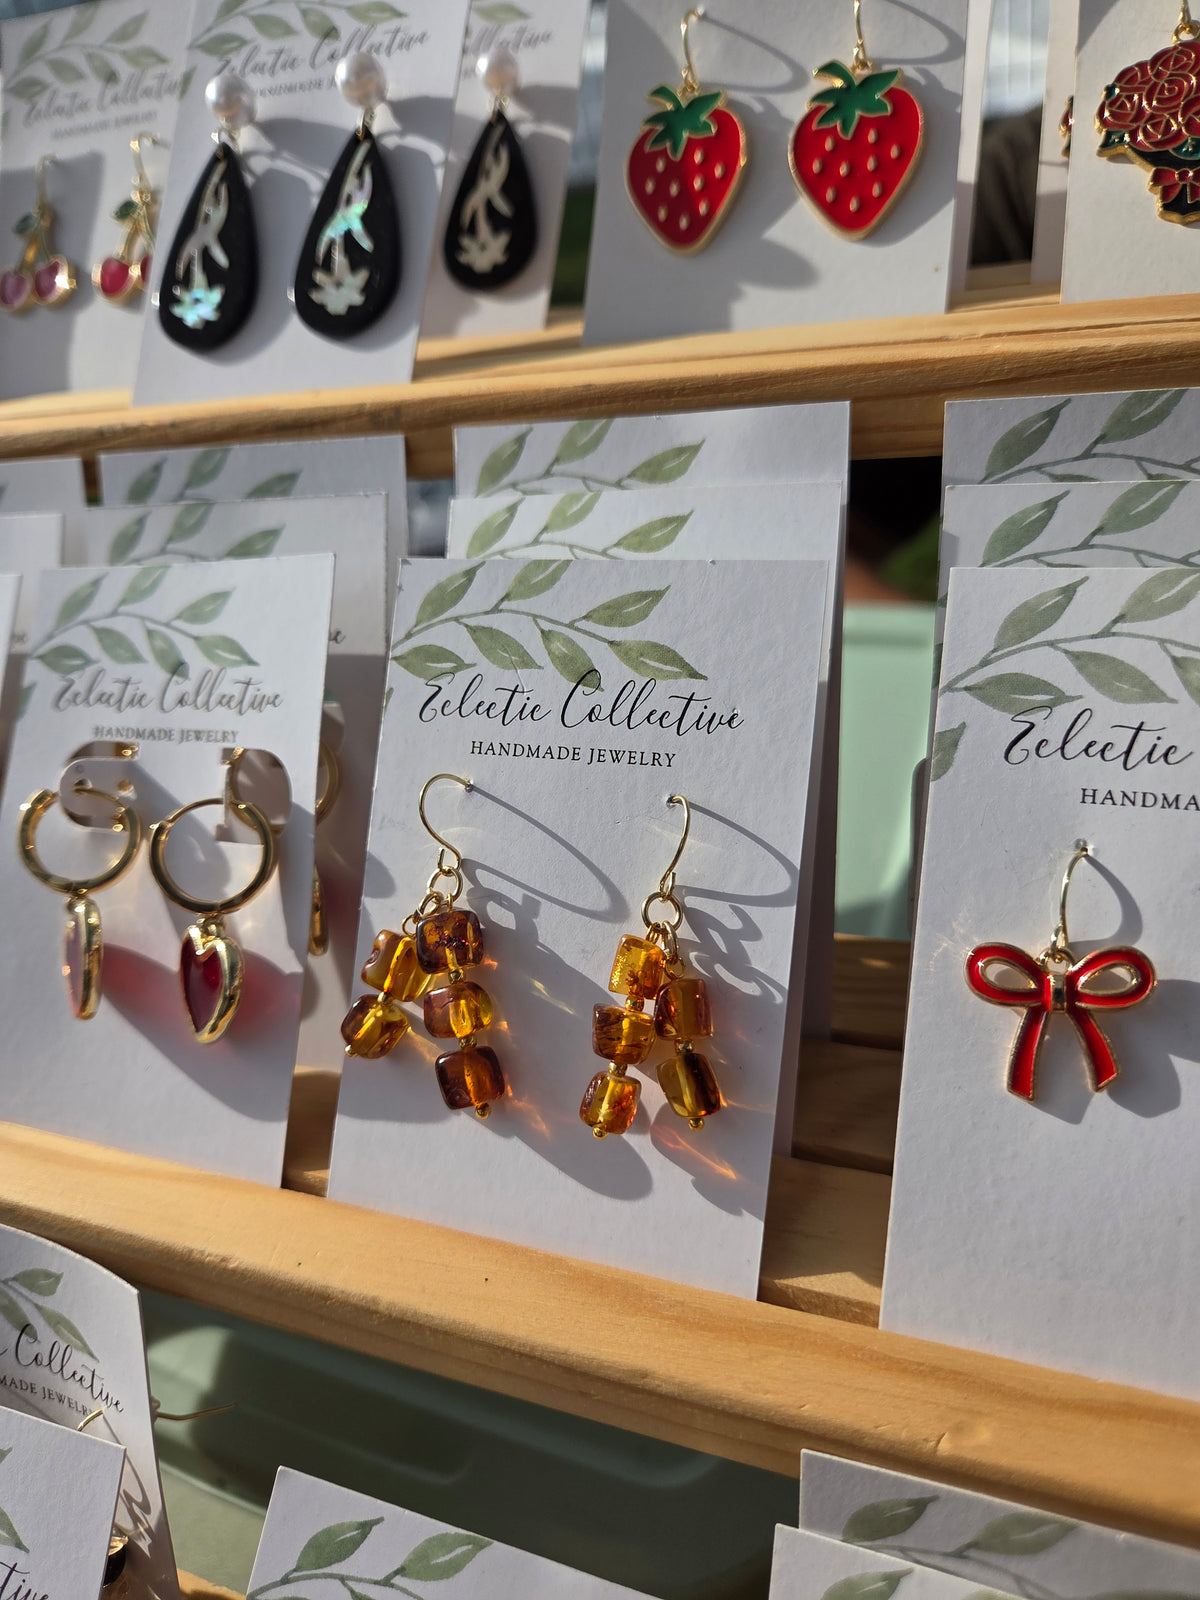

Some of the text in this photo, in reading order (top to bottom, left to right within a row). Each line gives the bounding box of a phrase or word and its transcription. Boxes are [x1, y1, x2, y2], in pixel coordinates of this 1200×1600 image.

[54, 661, 284, 716] Eclectic Collective
[418, 668, 745, 737] Eclectic Collective
[92, 725, 239, 744] HANDMADE JEWELRY
[470, 740, 677, 769] HANDMADE JEWELRY
[1003, 705, 1195, 772] Eclectic
[1079, 787, 1200, 812] HANDMA
[15, 1323, 124, 1413] Collective
[42, 1385, 93, 1417] JEWELR
